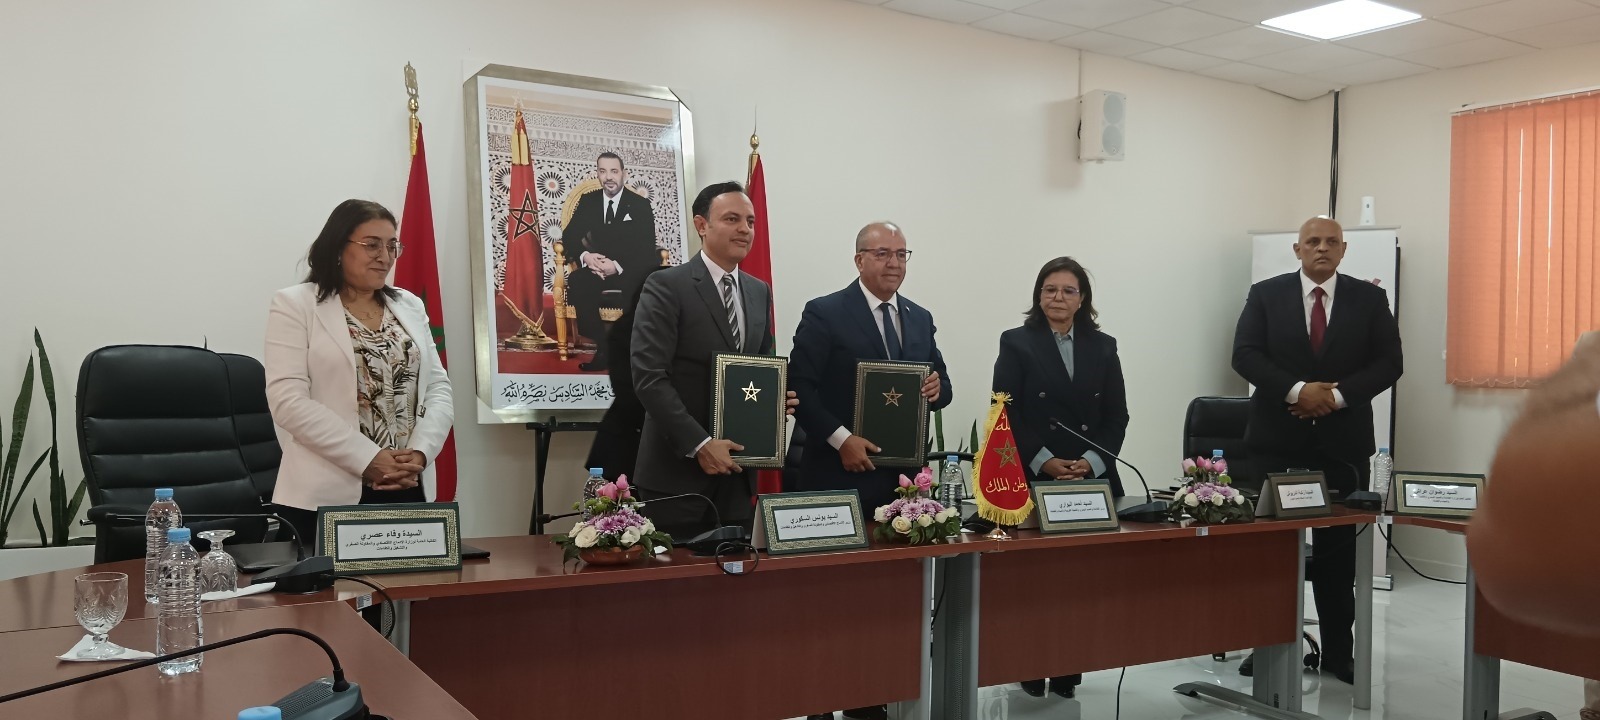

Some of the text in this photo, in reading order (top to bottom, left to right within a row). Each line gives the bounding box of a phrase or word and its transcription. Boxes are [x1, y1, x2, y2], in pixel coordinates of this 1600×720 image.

[500, 380, 521, 402] الله
[985, 477, 1010, 493] الملك
[790, 512, 839, 524] السيد يونس السكوري
[360, 529, 423, 541] السيدة وفاء عصري
